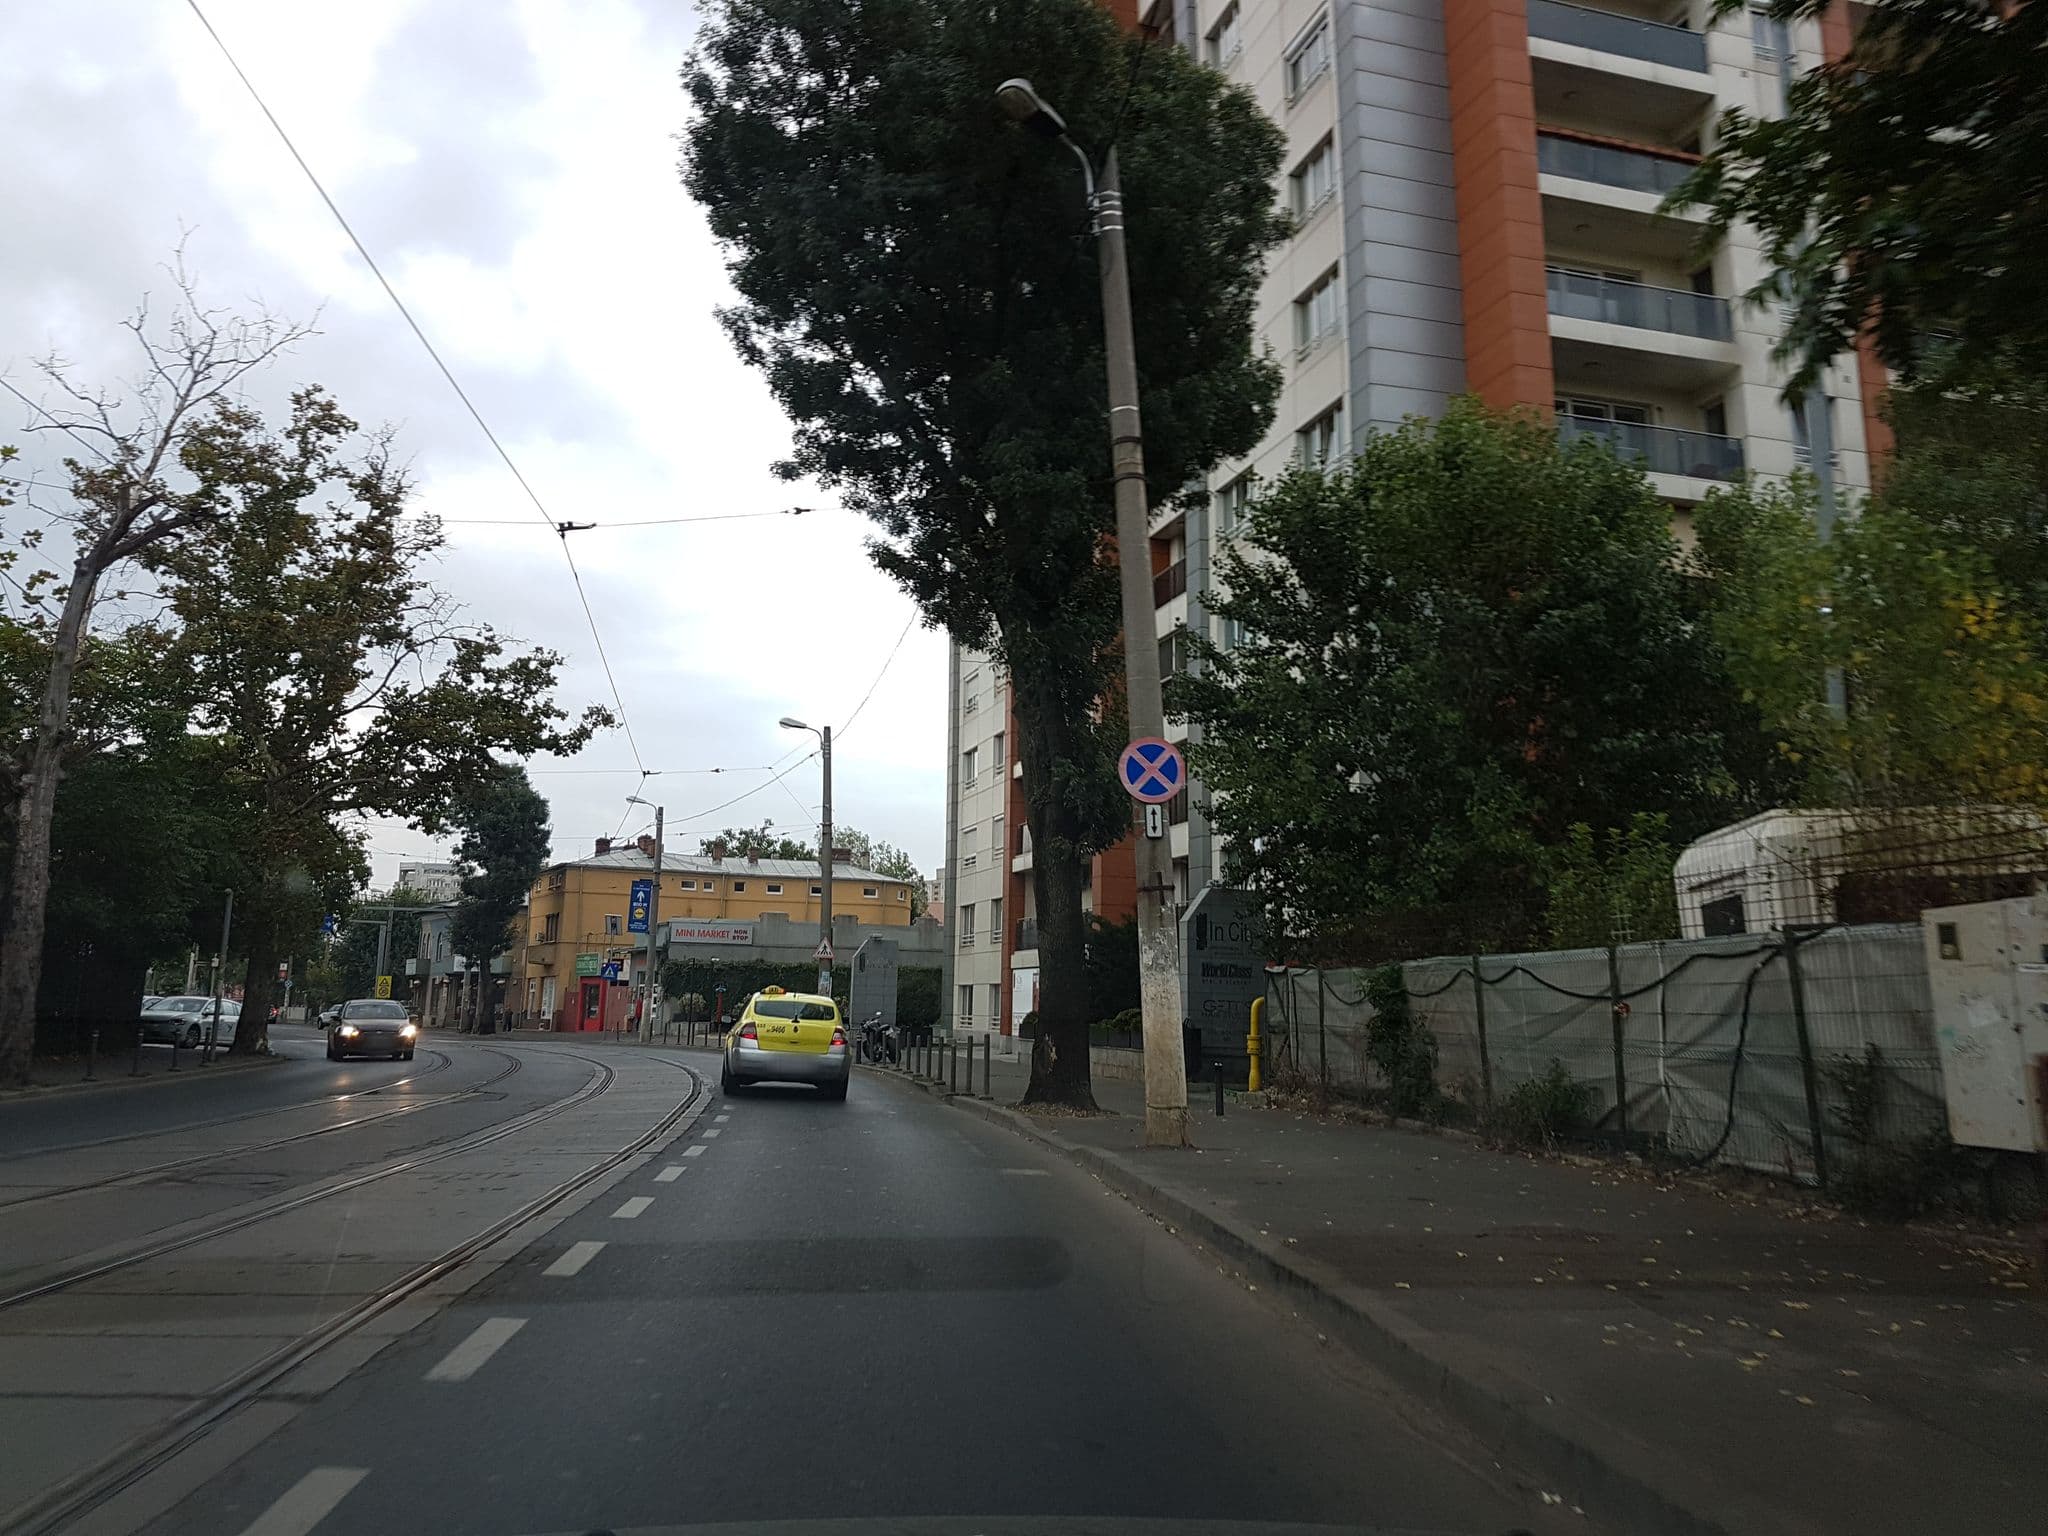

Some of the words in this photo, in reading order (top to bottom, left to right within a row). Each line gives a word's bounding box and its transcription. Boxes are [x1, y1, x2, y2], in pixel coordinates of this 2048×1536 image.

[675, 928, 695, 937] MINI
[697, 929, 730, 939] MARKET
[1210, 921, 1224, 942] In
